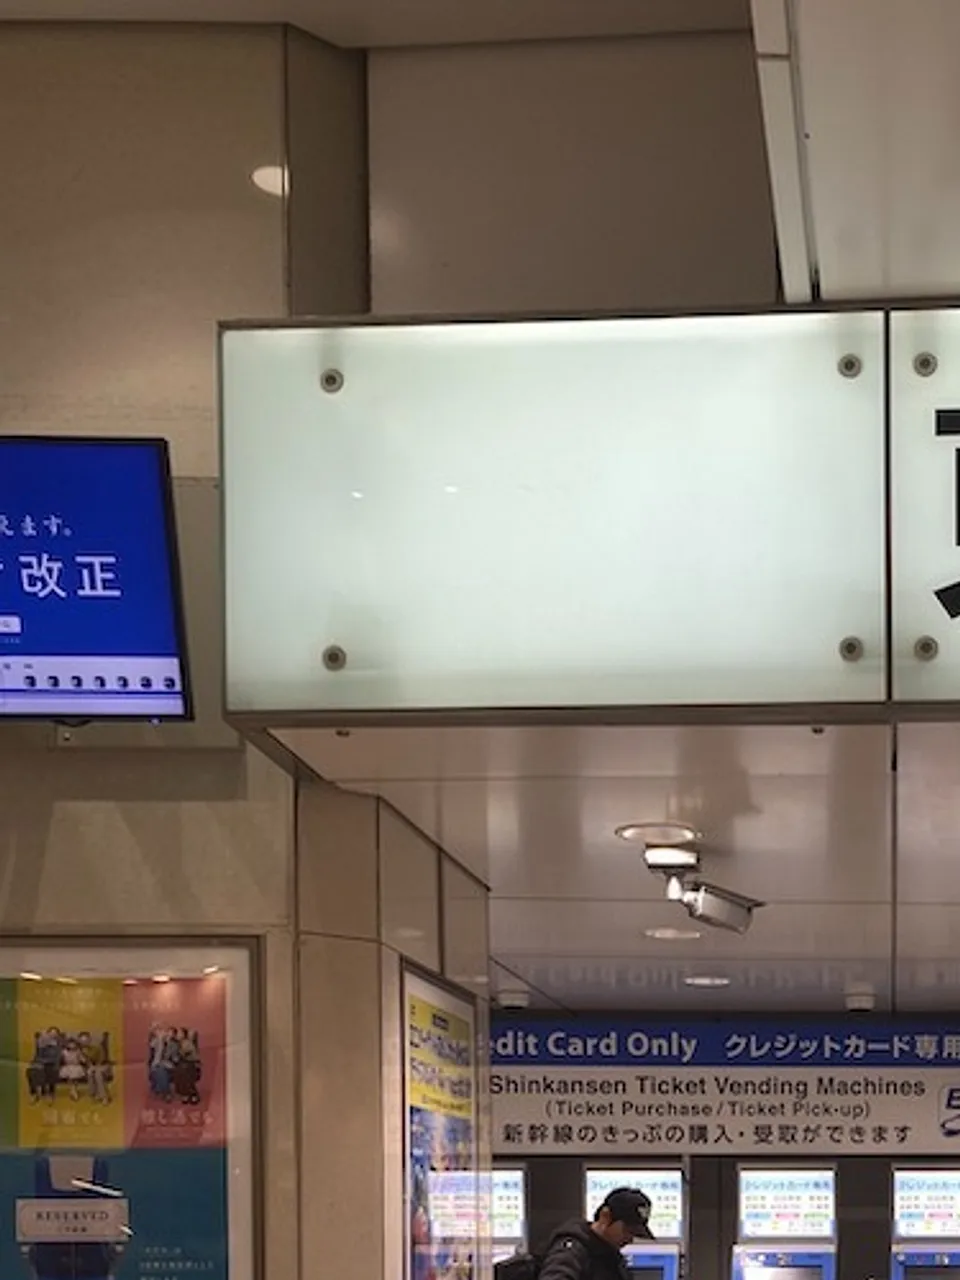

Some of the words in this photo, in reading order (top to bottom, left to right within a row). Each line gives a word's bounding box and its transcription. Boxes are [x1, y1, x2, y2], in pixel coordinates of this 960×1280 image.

[490, 1030, 539, 1057] dit
[547, 1031, 617, 1057] Card
[627, 1031, 697, 1063] Only
[489, 1074, 627, 1095] Shinkansen
[635, 1075, 706, 1095] Ticket
[714, 1076, 808, 1099] Vending
[816, 1077, 926, 1096] Machines
[545, 1100, 614, 1118] (Ticket
[502, 1124, 912, 1144] 新幹線のきっぷの購入・受取ができます
